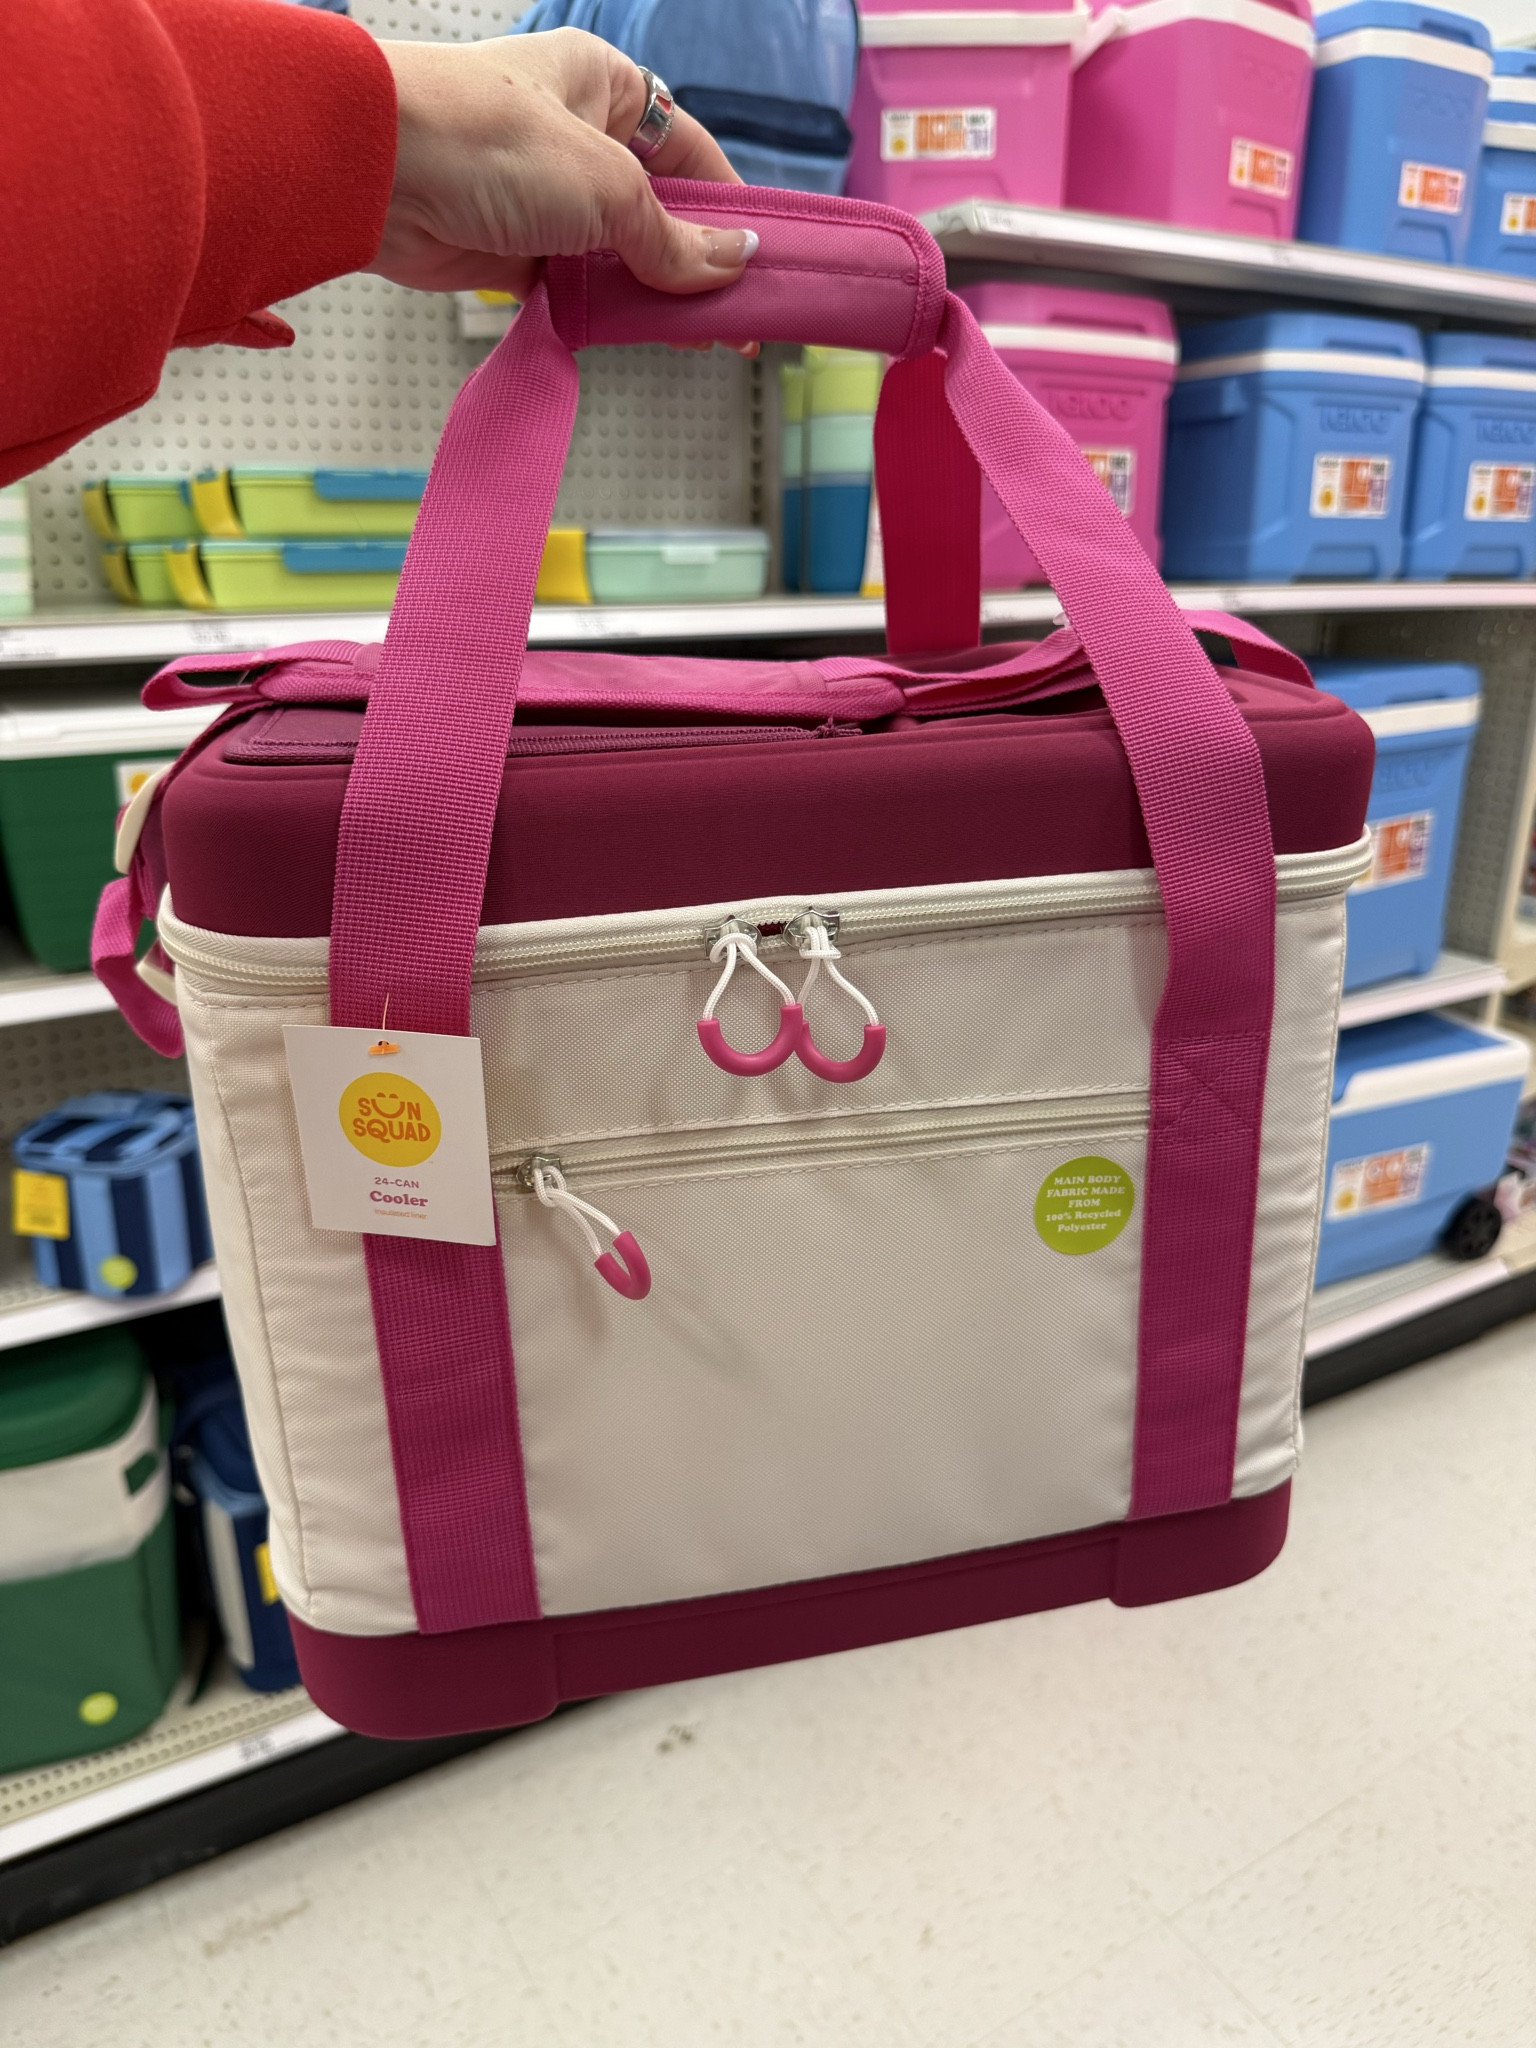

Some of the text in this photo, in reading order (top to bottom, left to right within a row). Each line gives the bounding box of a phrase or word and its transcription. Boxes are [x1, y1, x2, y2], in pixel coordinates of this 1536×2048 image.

[357, 1092, 422, 1121] SUN
[352, 1117, 431, 1143] SQUAD
[374, 1176, 420, 1188] 24-CAN
[1054, 1175, 1121, 1185] MAIN BODY
[1047, 1186, 1125, 1197] FABRIC MADE
[369, 1190, 428, 1207] Cooler
[1068, 1199, 1101, 1208] FROM
[1046, 1209, 1121, 1221] 100% Recycled
[1058, 1223, 1107, 1232] Polyester
